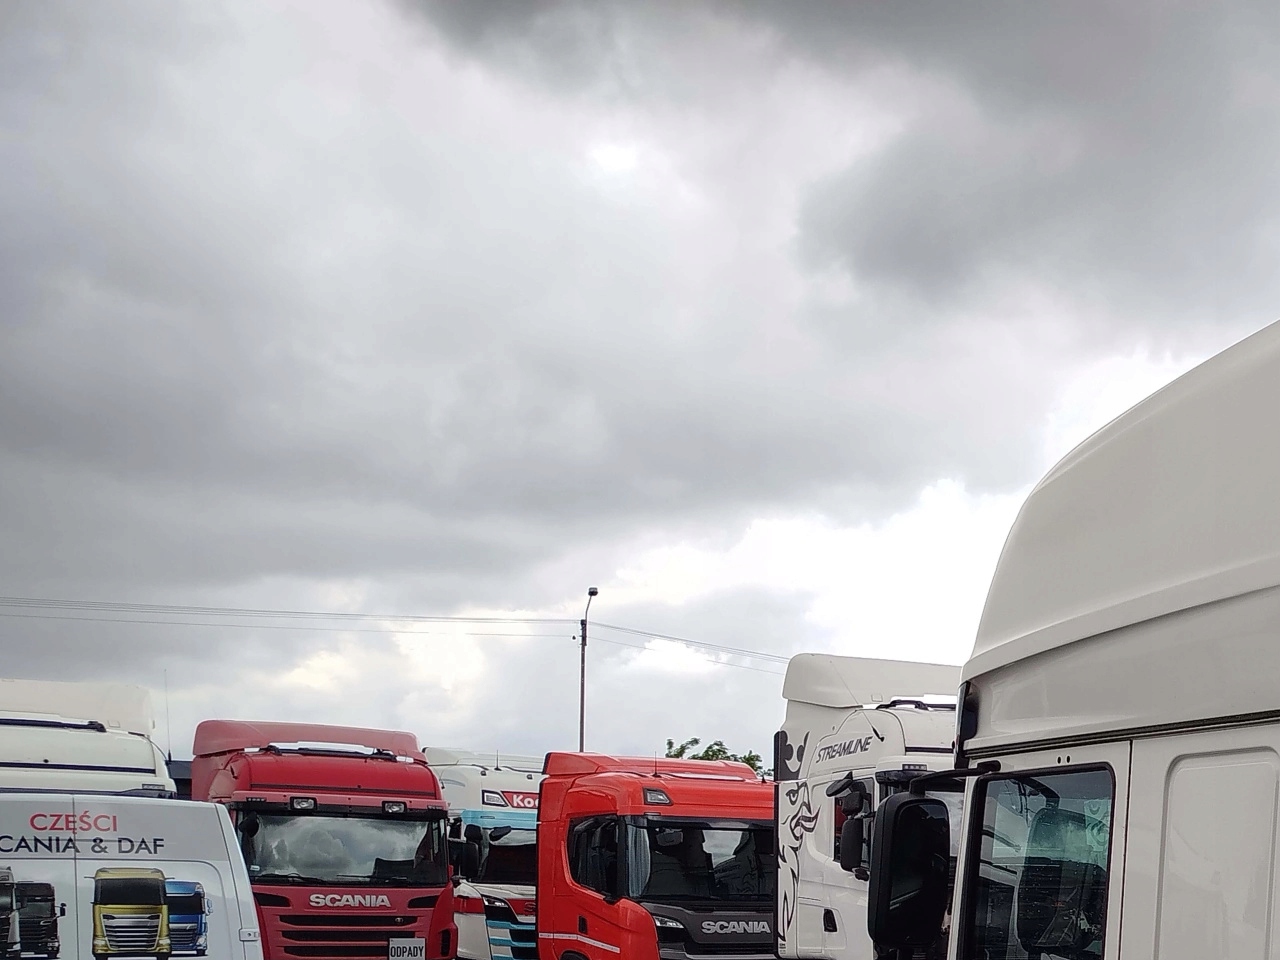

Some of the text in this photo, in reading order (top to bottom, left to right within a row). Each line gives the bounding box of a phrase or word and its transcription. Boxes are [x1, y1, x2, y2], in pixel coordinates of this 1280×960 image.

[816, 736, 873, 763] STREAMLINE
[29, 810, 117, 834] CZĘŚCI
[91, 837, 108, 853] &
[118, 837, 164, 854] DAF
[309, 894, 391, 907] SCANIA
[701, 921, 771, 933] SCANIA
[390, 946, 423, 957] ODPADY
